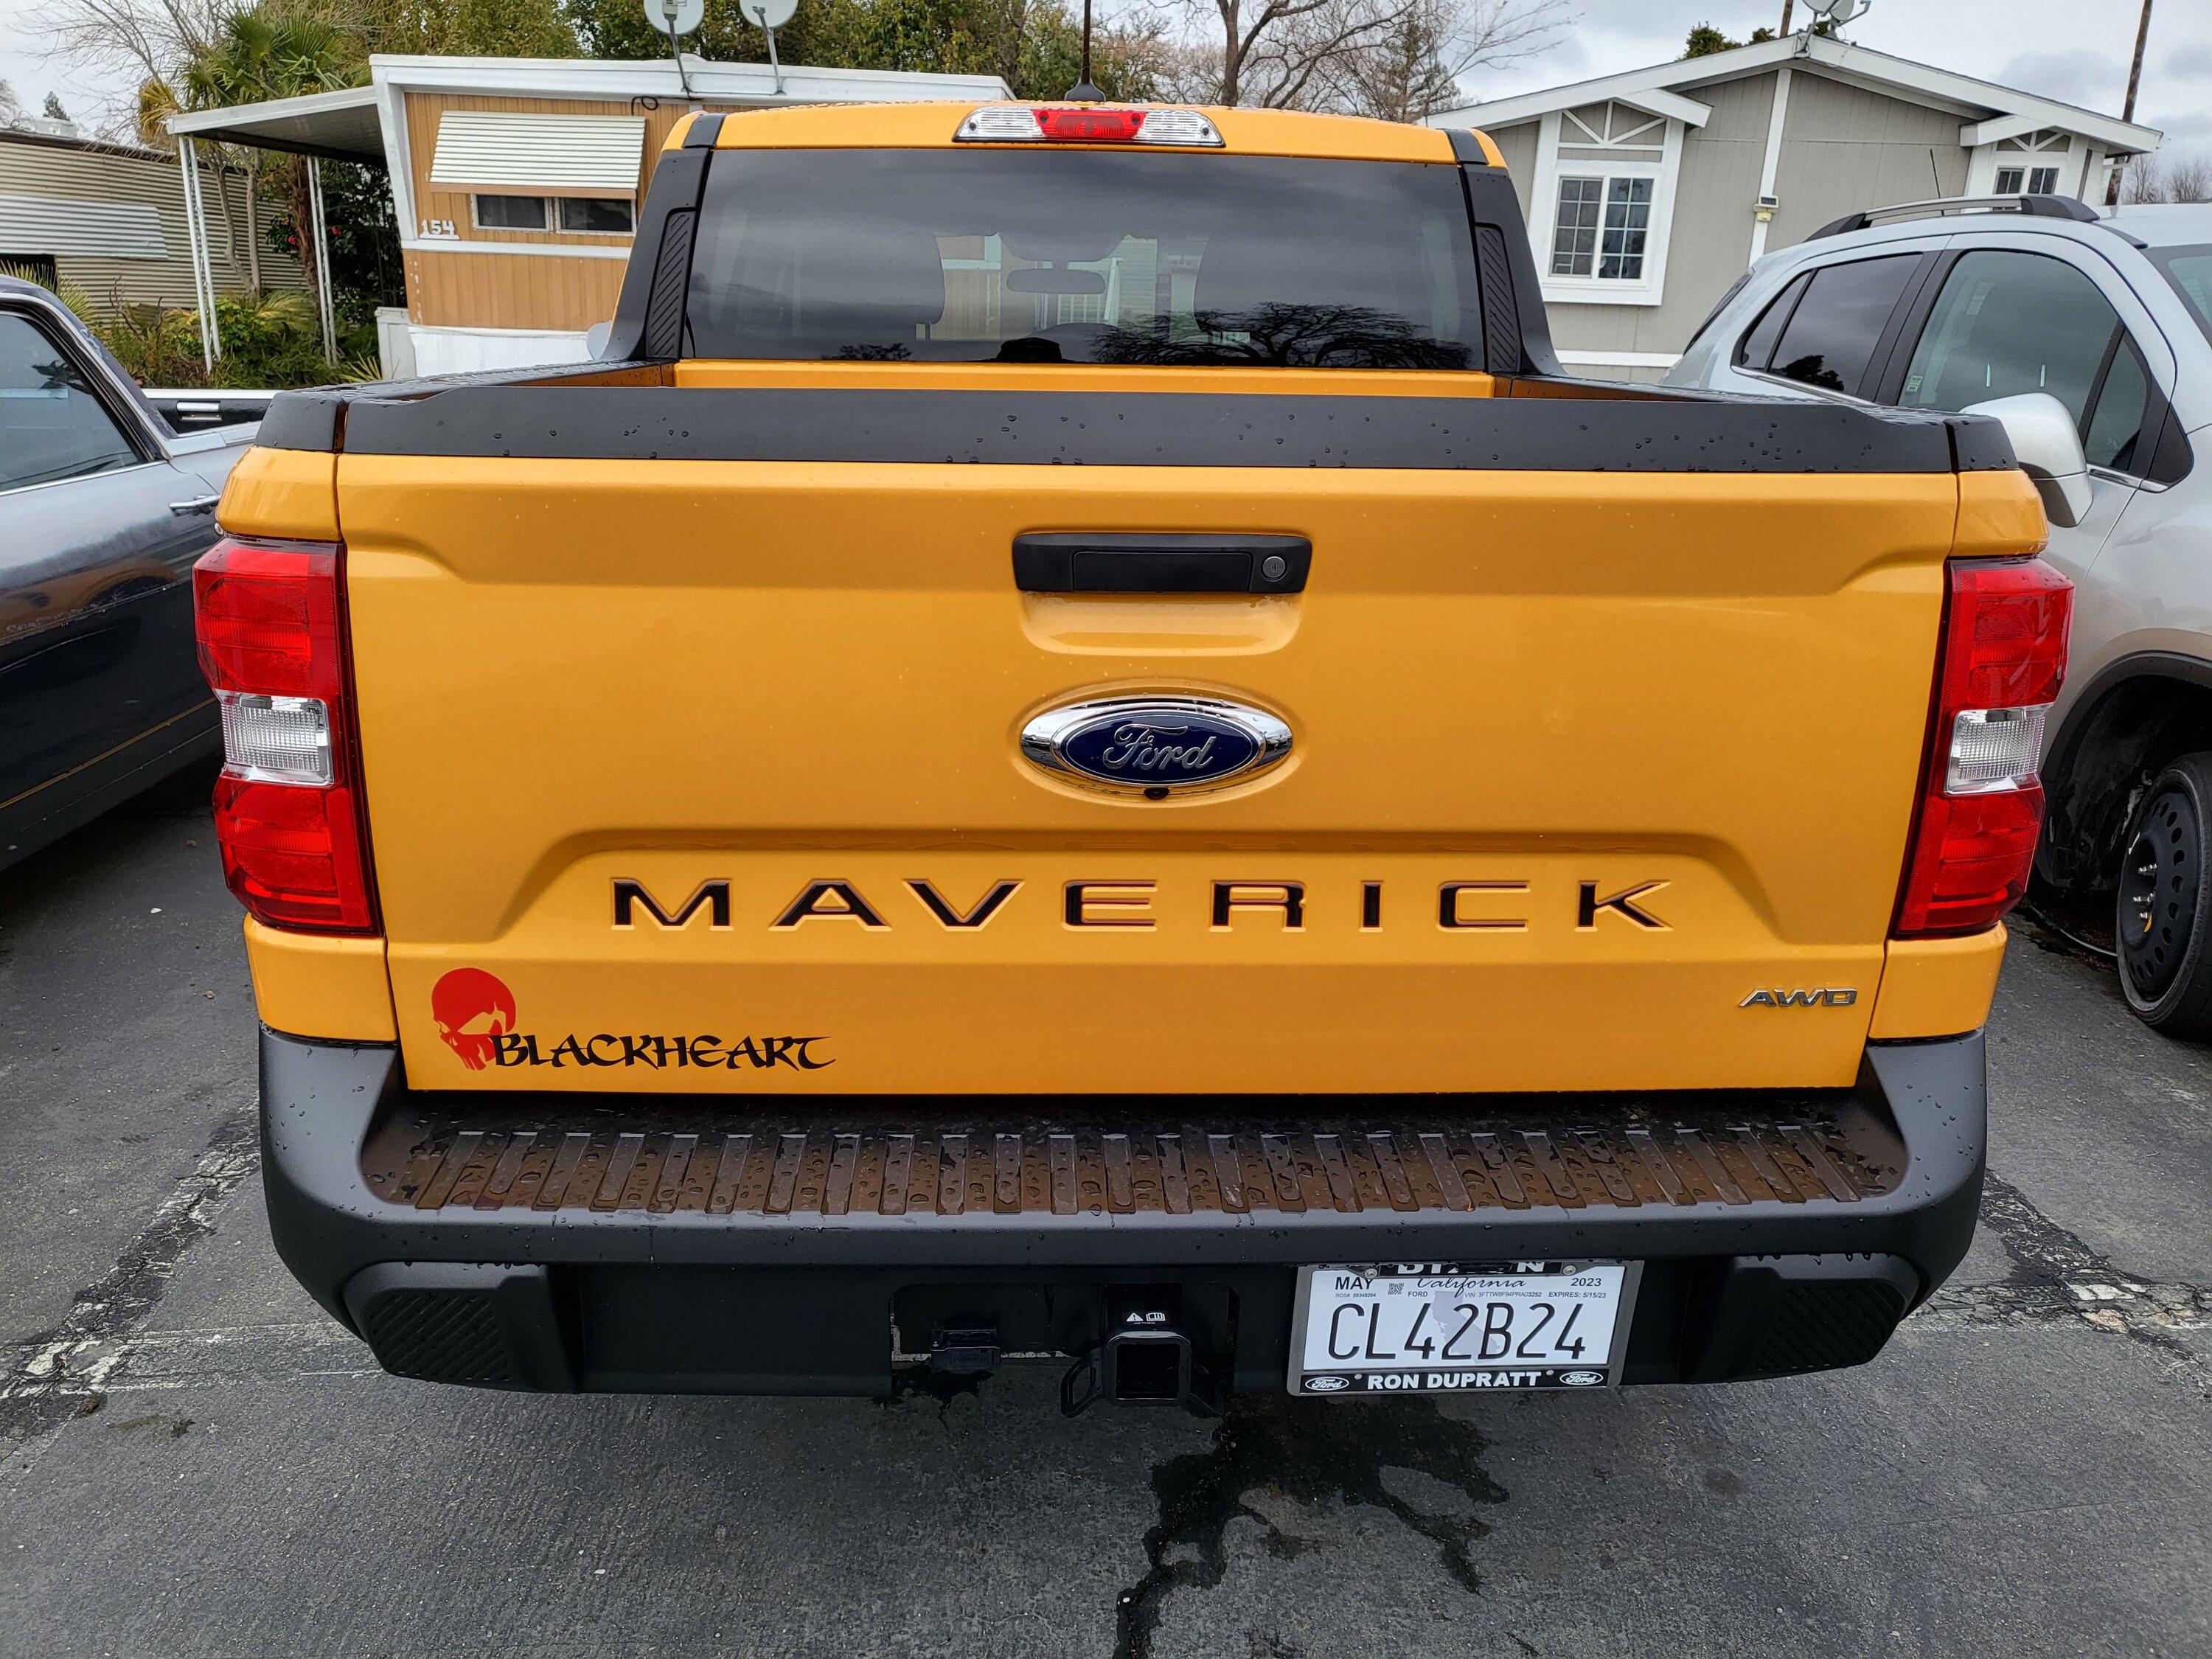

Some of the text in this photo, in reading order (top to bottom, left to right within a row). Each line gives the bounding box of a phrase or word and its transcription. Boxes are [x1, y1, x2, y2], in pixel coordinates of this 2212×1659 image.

[420, 219, 456, 237] 154
[1102, 724, 1217, 770] Ford
[612, 879, 1672, 931] MAVERICK
[1738, 988, 1858, 1009] AWD
[491, 1033, 836, 1071] BLACKHEART
[1335, 1276, 1373, 1290] MAY
[1417, 1278, 1526, 1298] California
[1571, 1278, 1602, 1287] 2023
[1328, 1302, 1585, 1360] CL42B24
[1311, 1378, 1343, 1389] Ford
[1367, 1371, 1542, 1390] RON DUPRATT
[1565, 1373, 1597, 1384] Ford
